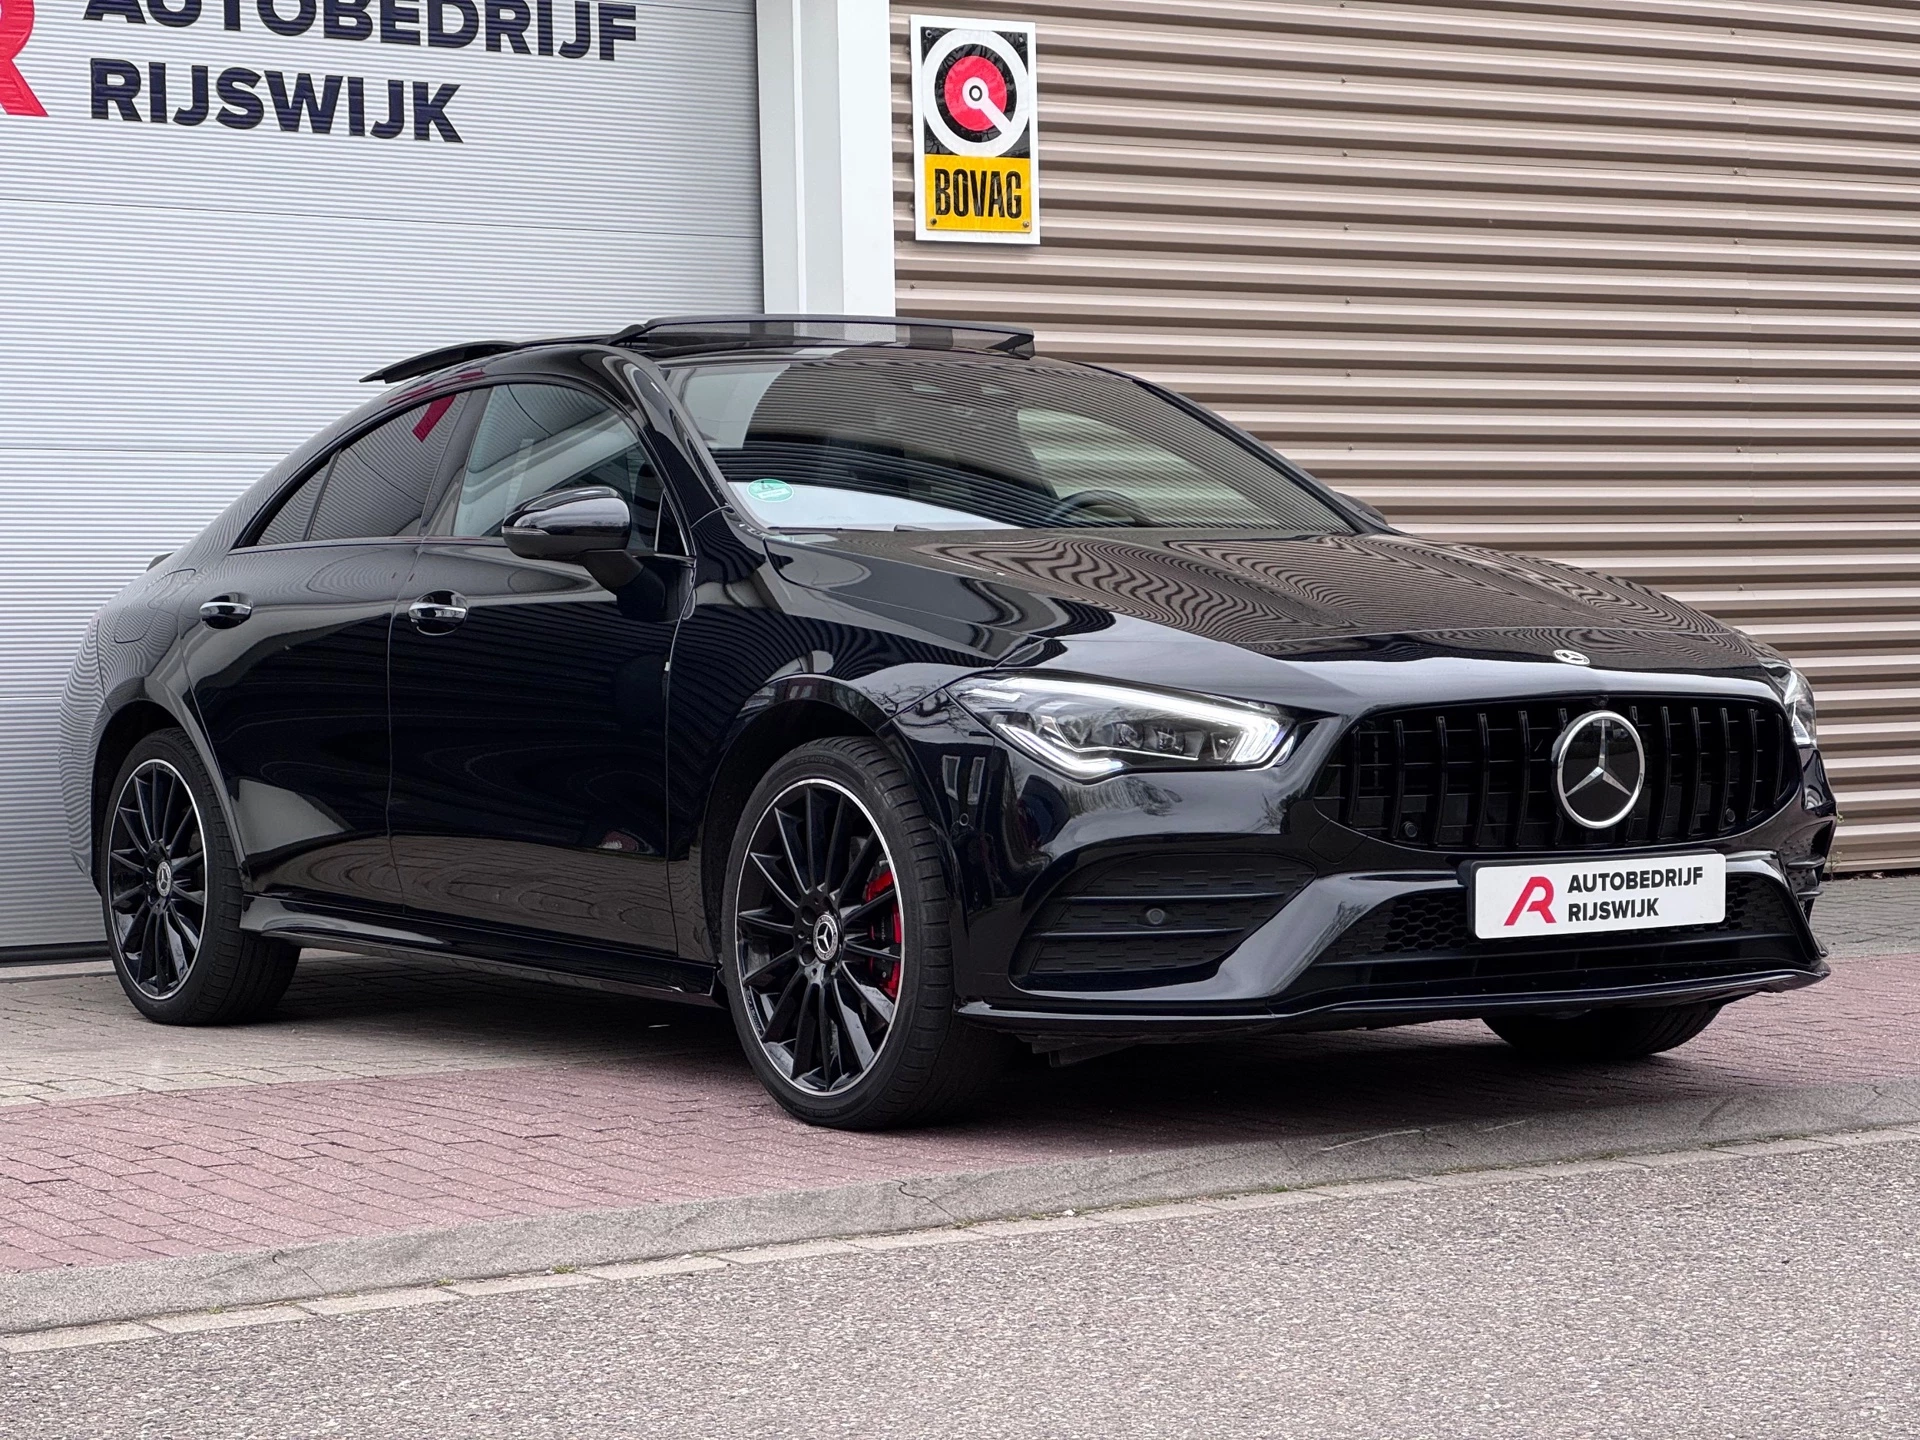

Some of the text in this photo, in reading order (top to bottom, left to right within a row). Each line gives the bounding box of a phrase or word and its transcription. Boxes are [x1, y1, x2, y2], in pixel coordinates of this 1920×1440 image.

[90, 57, 464, 144] RIJSWIJK
[934, 168, 1022, 219] BOVAG
[1567, 866, 1704, 894] AUTOBEDRIJF
[1567, 898, 1660, 922] RIJSWIJK
